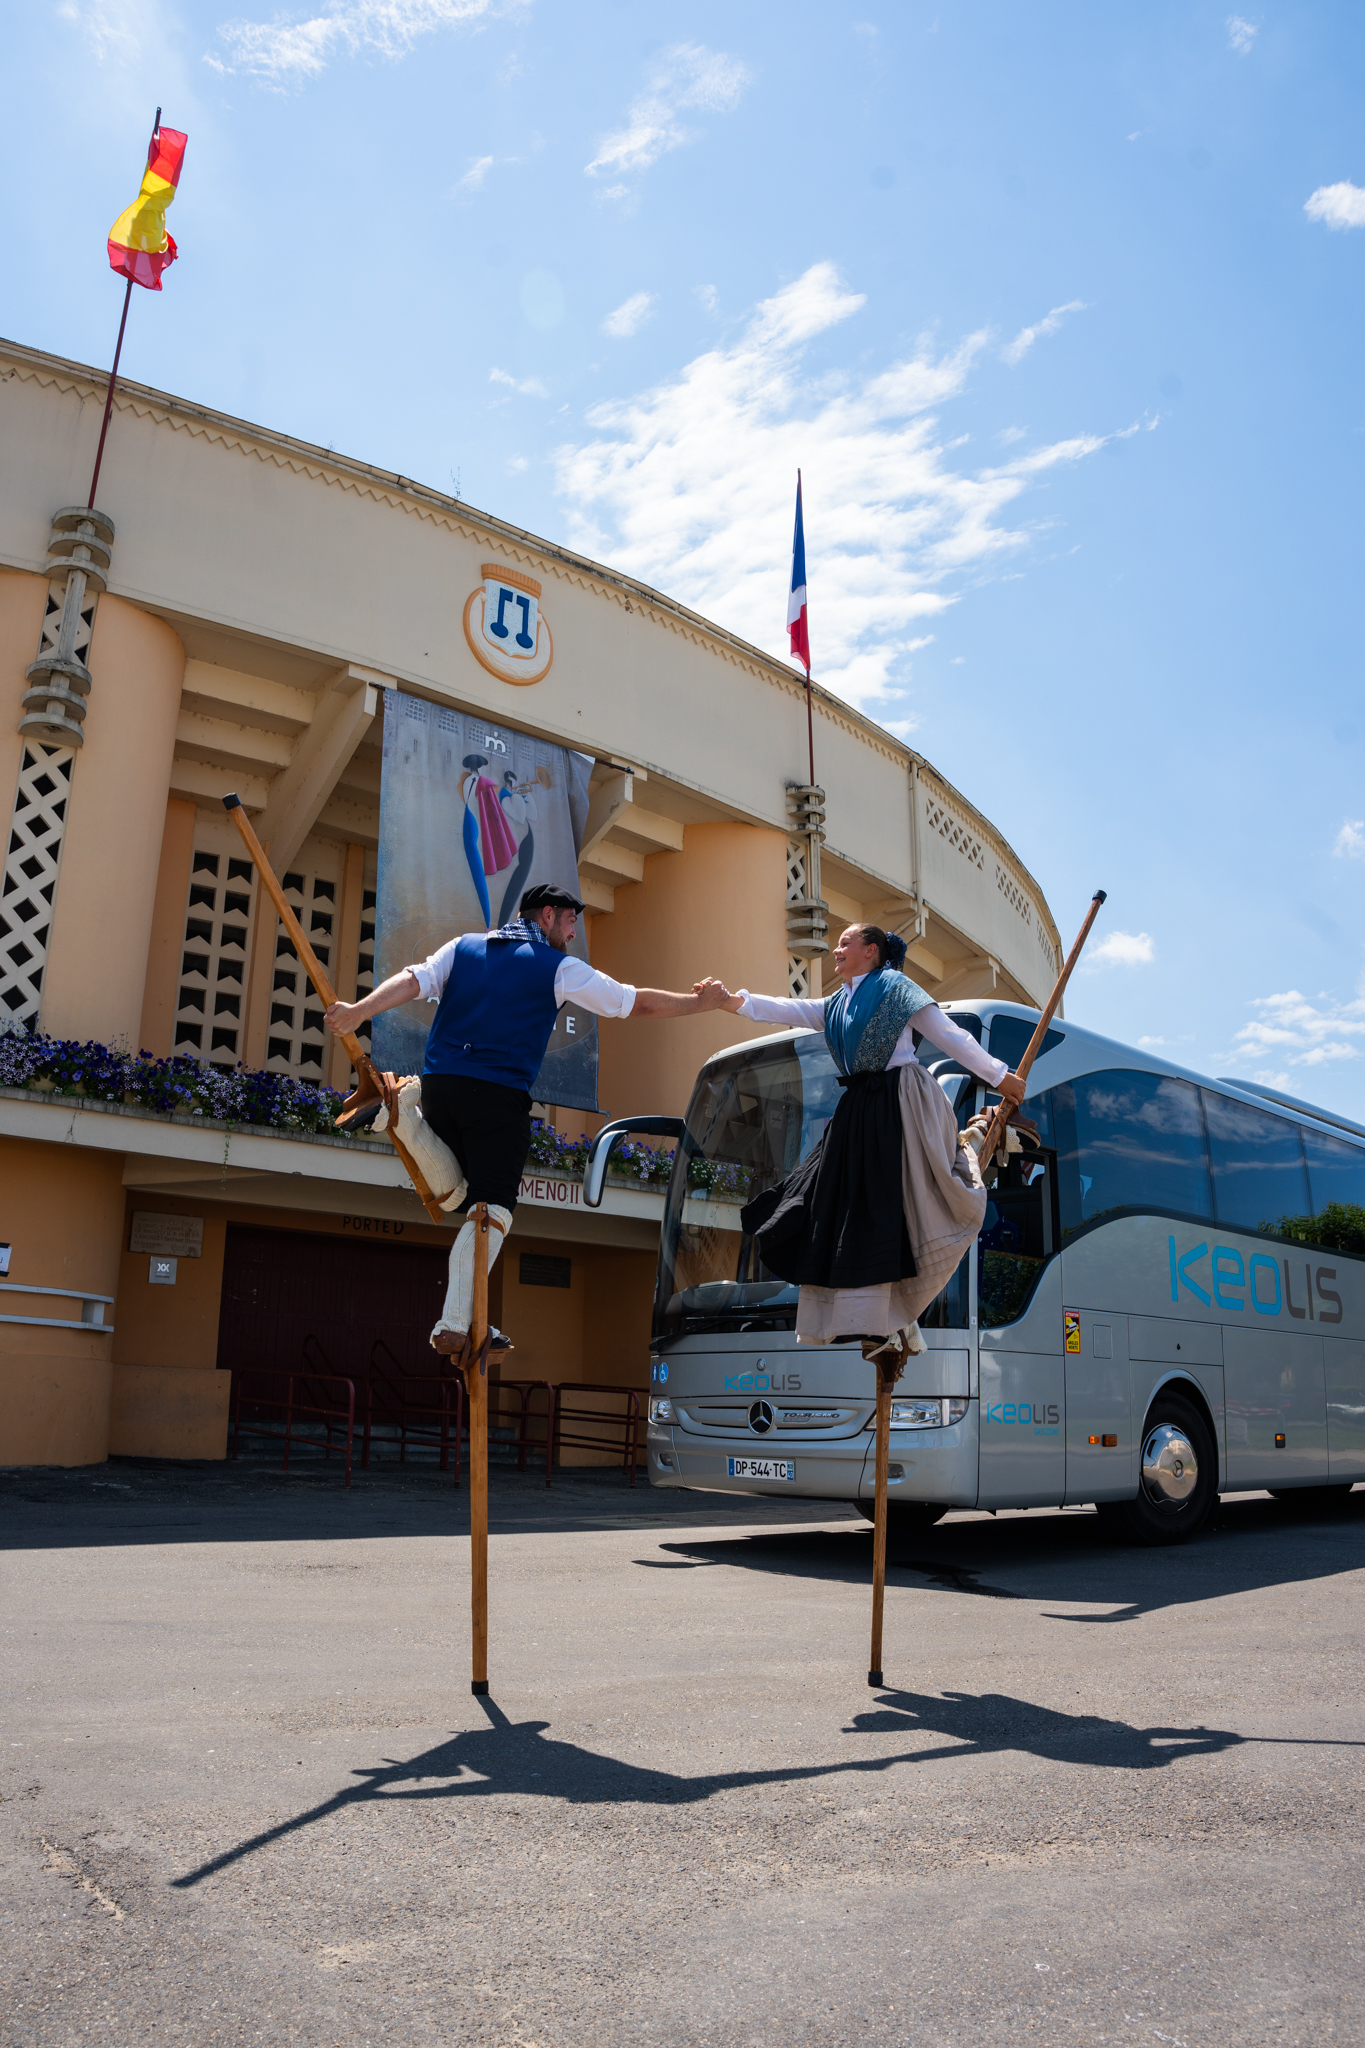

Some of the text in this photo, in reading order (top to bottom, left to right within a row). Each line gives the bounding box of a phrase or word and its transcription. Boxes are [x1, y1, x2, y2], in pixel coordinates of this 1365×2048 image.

[517, 1178, 579, 1204] MENO II
[343, 1215, 389, 1233] PORTE
[1034, 1427, 1060, 1436] GASCOGNE
